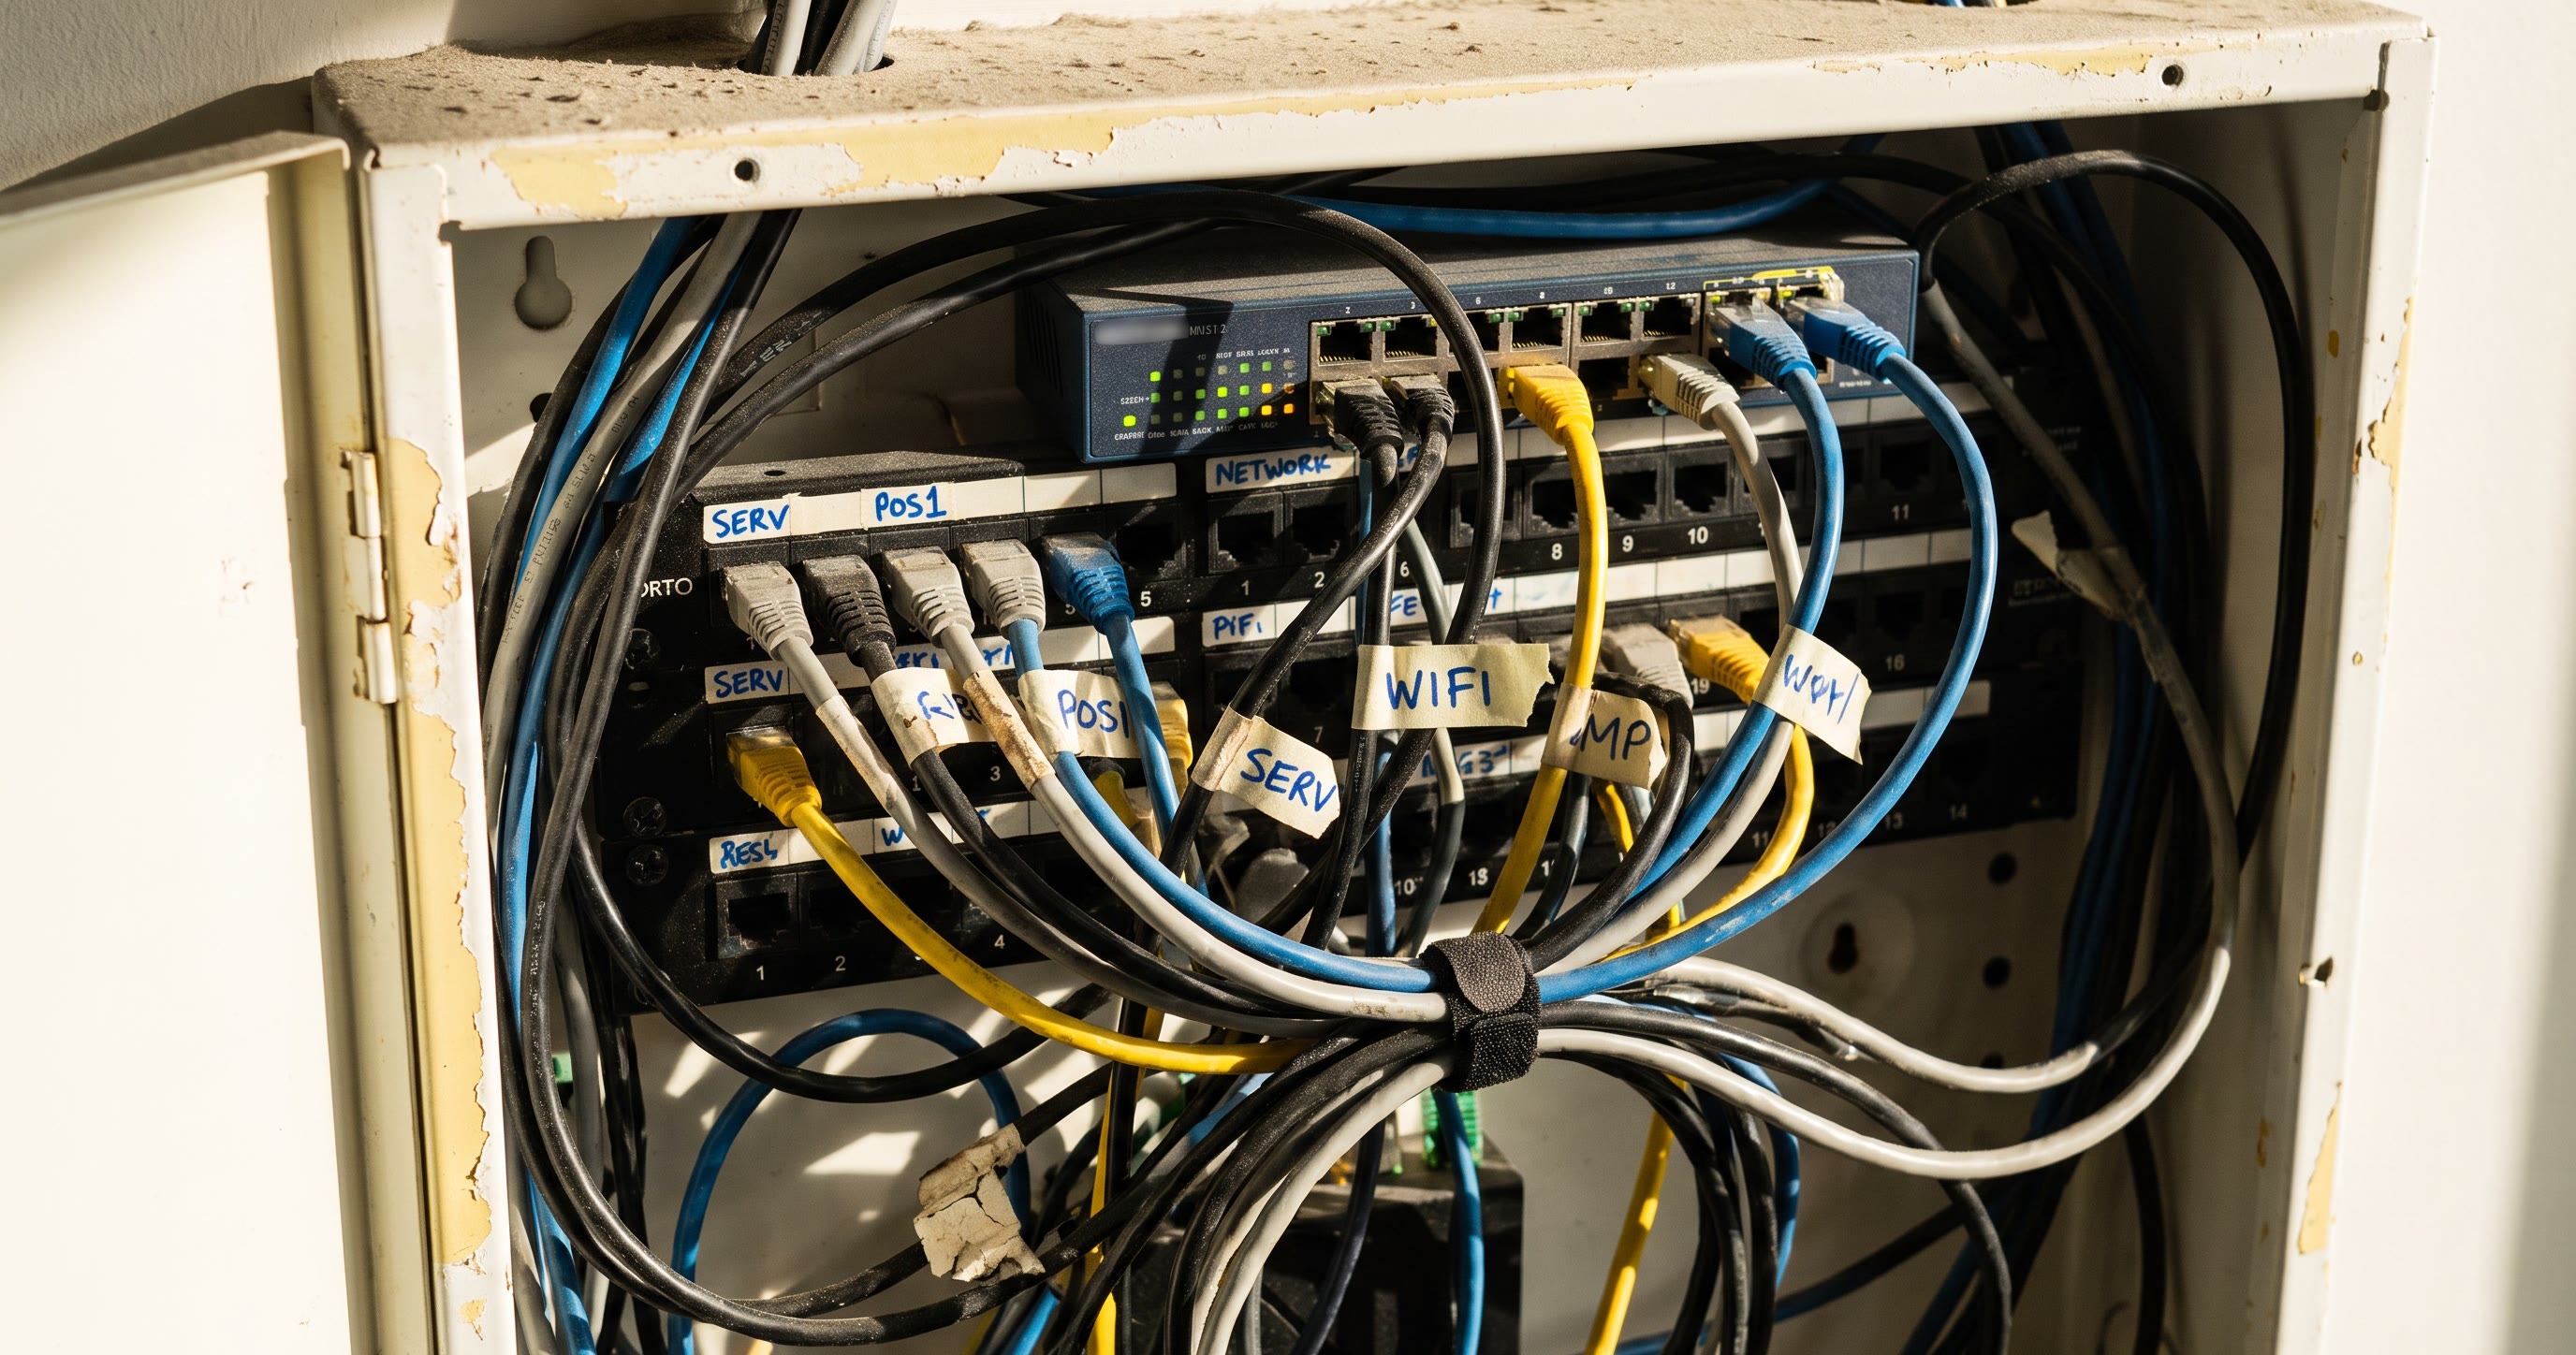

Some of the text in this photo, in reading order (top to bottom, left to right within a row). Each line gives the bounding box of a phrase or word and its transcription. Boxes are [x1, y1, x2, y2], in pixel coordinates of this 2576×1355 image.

[1216, 453, 1331, 486] NETWORK
[875, 486, 948, 522] POS1
[1891, 503, 1910, 521] 11
[712, 503, 790, 538] SERV
[1622, 534, 1634, 553] 9
[1688, 526, 1708, 546] 10
[1551, 543, 1563, 560] 8
[1399, 561, 1410, 577] 6
[1240, 579, 1251, 596] 1
[1314, 571, 1325, 589] 2
[1140, 590, 1151, 607] 5
[713, 667, 783, 698] SERV
[1386, 665, 1490, 710] WIFI
[989, 765, 1002, 781] 3
[1240, 748, 1338, 812] SERV
[1949, 803, 1969, 821] 14
[994, 935, 1005, 950] 4
[834, 955, 846, 972] 2
[756, 965, 765, 981] 1
